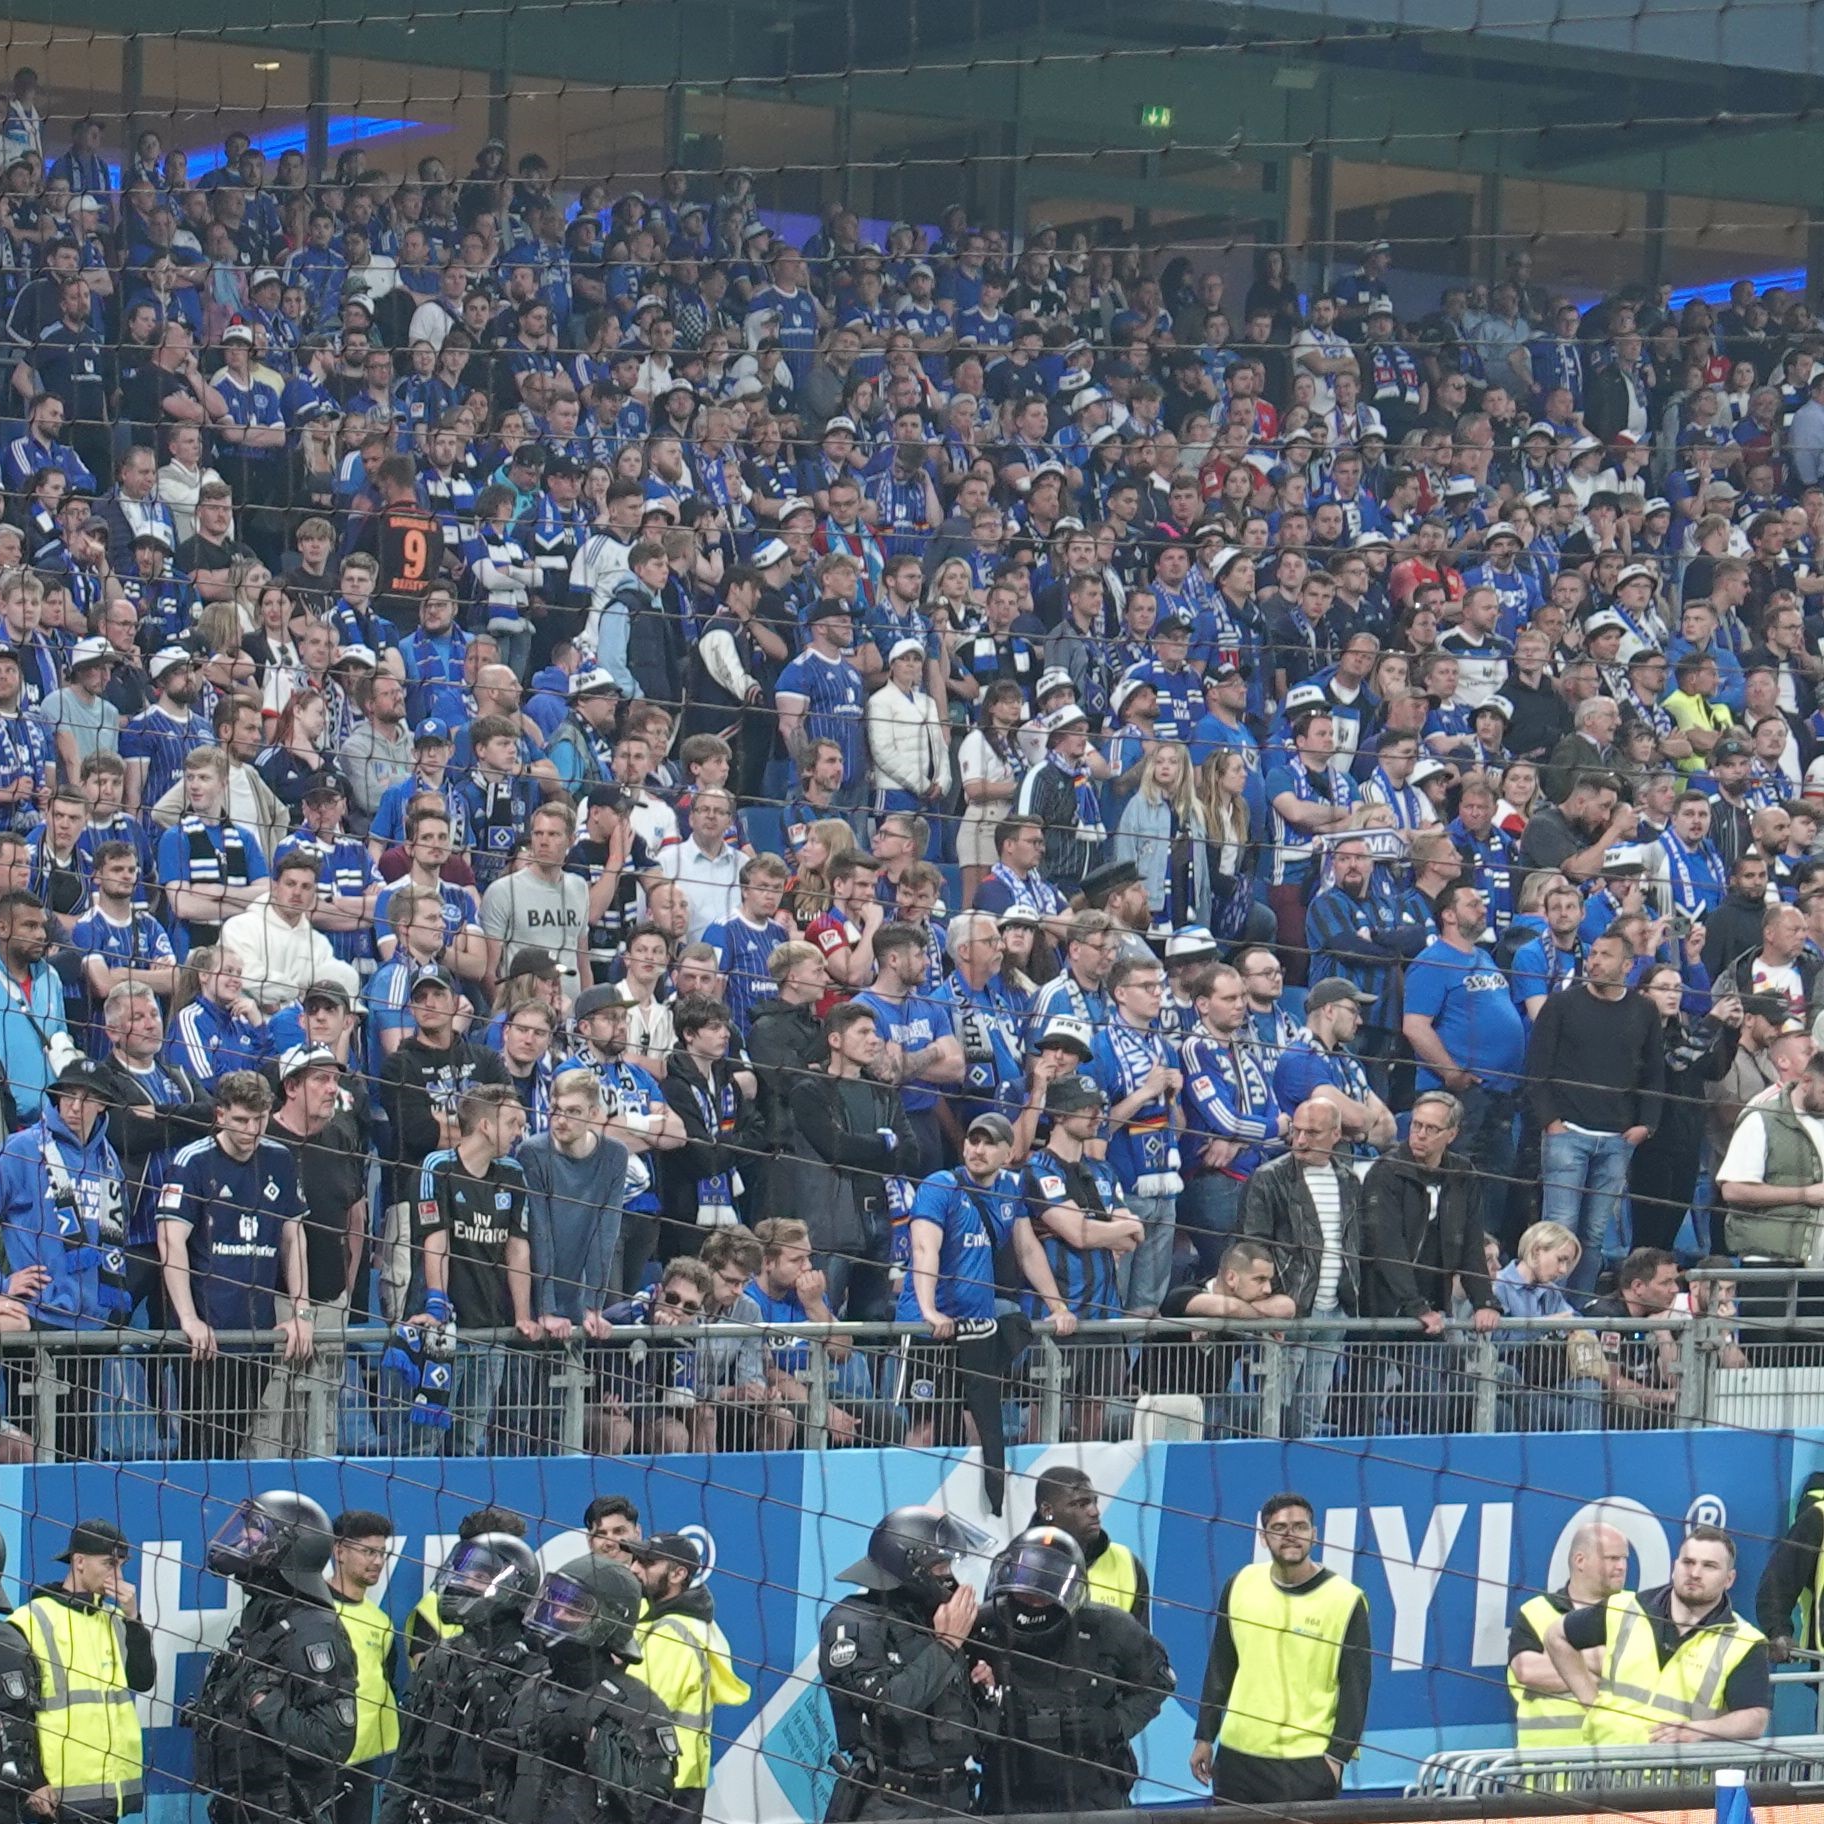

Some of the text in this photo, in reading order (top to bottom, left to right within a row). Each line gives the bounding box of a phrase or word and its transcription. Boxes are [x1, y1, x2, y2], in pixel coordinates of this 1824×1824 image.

[403, 529, 428, 580] 9
[527, 910, 582, 927] BALR.
[1056, 1020, 1082, 1033] HSV
